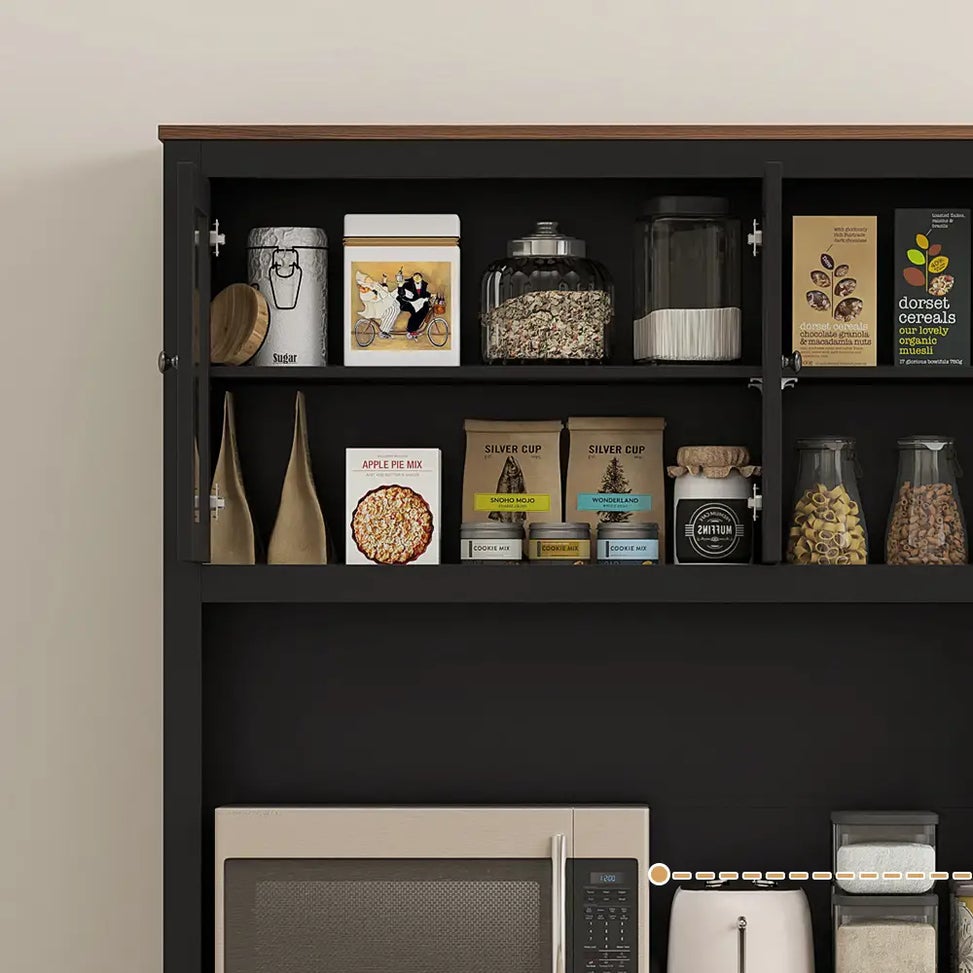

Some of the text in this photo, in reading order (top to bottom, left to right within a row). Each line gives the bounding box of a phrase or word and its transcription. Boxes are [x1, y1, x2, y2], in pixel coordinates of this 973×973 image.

[898, 296, 951, 310] dorset
[898, 310, 957, 324] cereals
[800, 322, 869, 331] dorset cereals
[898, 326, 949, 337] our lovely
[799, 330, 870, 339] chocolate granola
[799, 338, 807, 346] &
[808, 338, 853, 346] macadamia
[898, 336, 938, 347] organic
[898, 346, 934, 355] muesli
[272, 352, 298, 365] Sugar
[484, 444, 542, 454] SILVER CUP
[588, 444, 646, 454] SILVER CUP
[362, 460, 423, 469] APPLE PIE MIX
